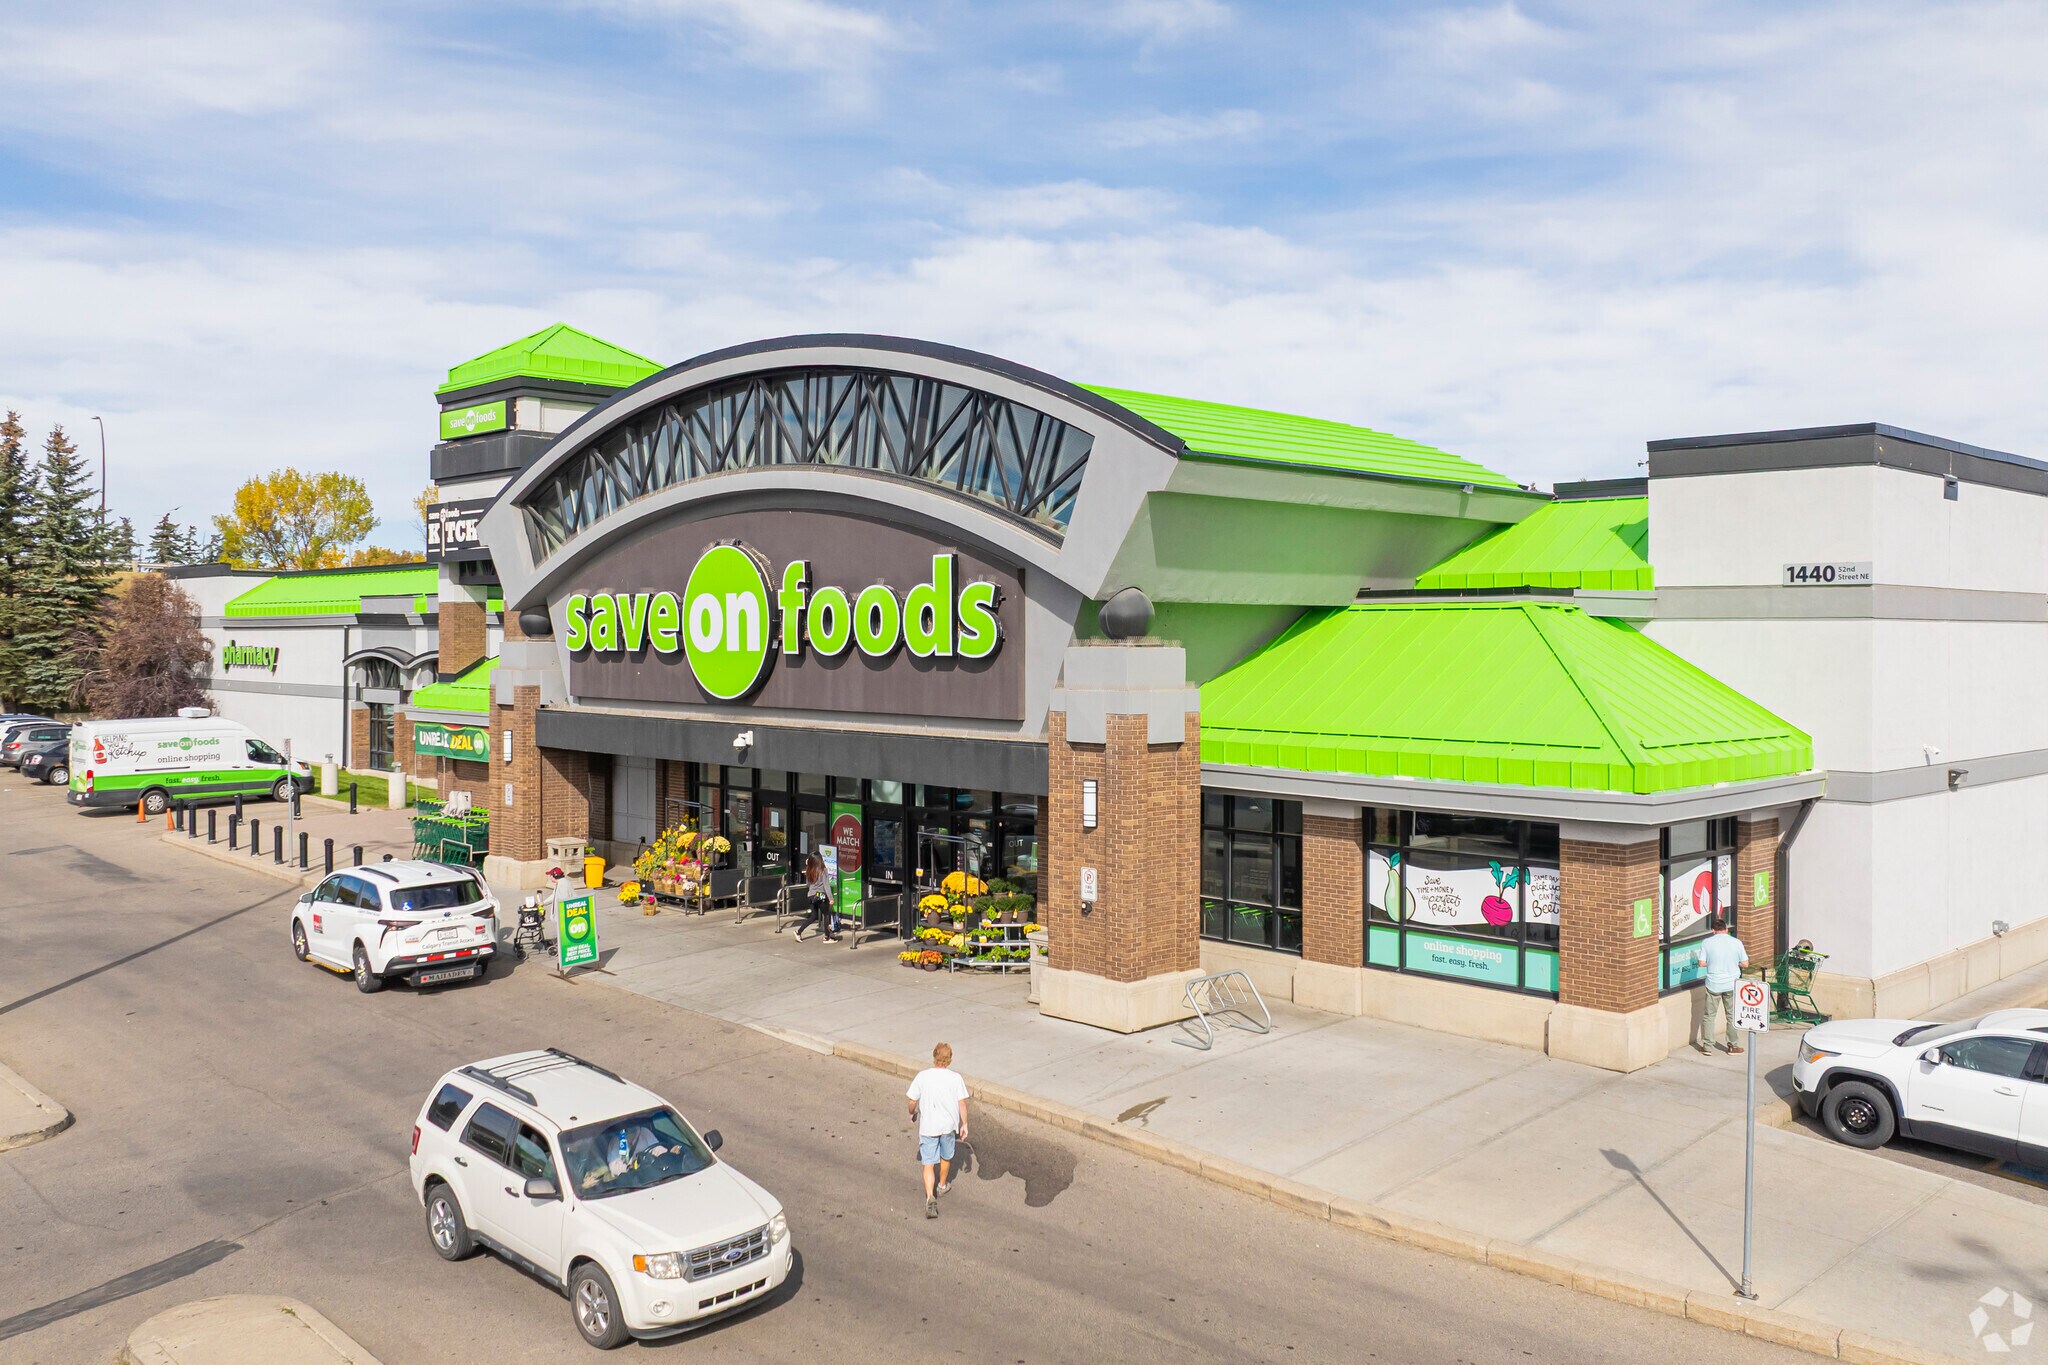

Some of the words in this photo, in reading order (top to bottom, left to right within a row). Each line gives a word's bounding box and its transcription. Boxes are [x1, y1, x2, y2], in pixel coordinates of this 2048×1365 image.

[1787, 565, 1836, 583] 1440
[1838, 573, 1859, 581] Street
[565, 591, 681, 653] save
[688, 591, 761, 653] on
[778, 554, 998, 658] foods
[222, 640, 277, 672] pharmacy
[157, 740, 179, 749] save
[193, 737, 220, 746] foods
[450, 735, 473, 750] DEAL
[157, 755, 183, 763] online
[184, 753, 221, 762] shopping
[843, 827, 854, 837] WE
[836, 836, 860, 847] MATCH
[766, 852, 780, 861] OUT
[885, 870, 894, 880] IN
[566, 906, 588, 918] DEAL
[570, 923, 586, 934] on
[421, 942, 442, 951] Calgary
[1424, 940, 1454, 954] online
[1456, 944, 1503, 963] shopping
[1431, 953, 1447, 963] fast.
[1448, 958, 1468, 969] easy.
[1468, 960, 1490, 970] fresh.
[1742, 1005, 1761, 1014] FIRE
[1740, 1013, 1762, 1021] LANE
